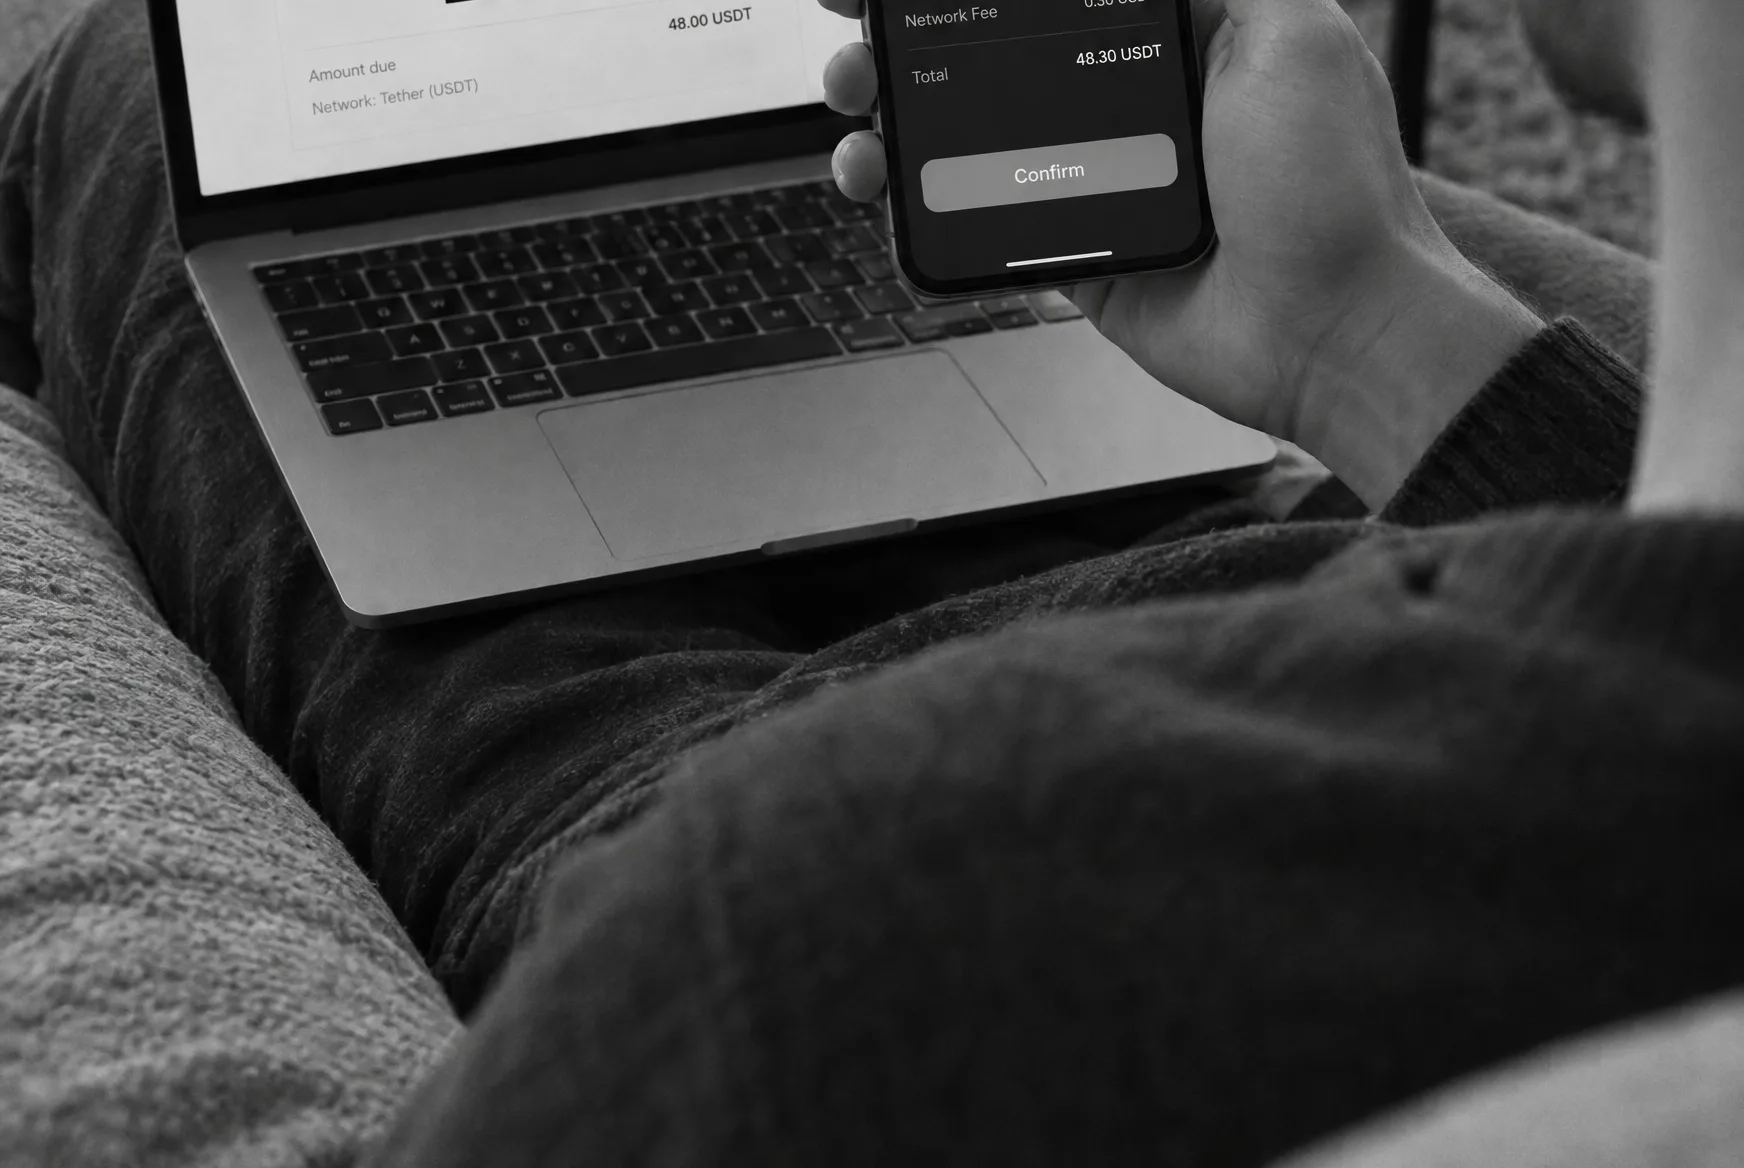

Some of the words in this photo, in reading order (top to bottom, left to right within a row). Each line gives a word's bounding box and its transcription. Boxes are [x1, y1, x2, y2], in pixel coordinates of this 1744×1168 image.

[668, 13, 709, 31] 48.00
[711, 6, 752, 25] USDT
[905, 8, 968, 28] Network
[971, 6, 998, 21] Fee
[1076, 49, 1117, 66] 48.30
[1120, 43, 1162, 61] USDT
[308, 63, 366, 83] Amount
[369, 60, 397, 74] due
[911, 67, 949, 85] Total
[312, 94, 377, 116] Network:
[379, 88, 425, 105] Tether
[428, 78, 479, 100] (USDT)
[1014, 164, 1085, 184] Confirm
